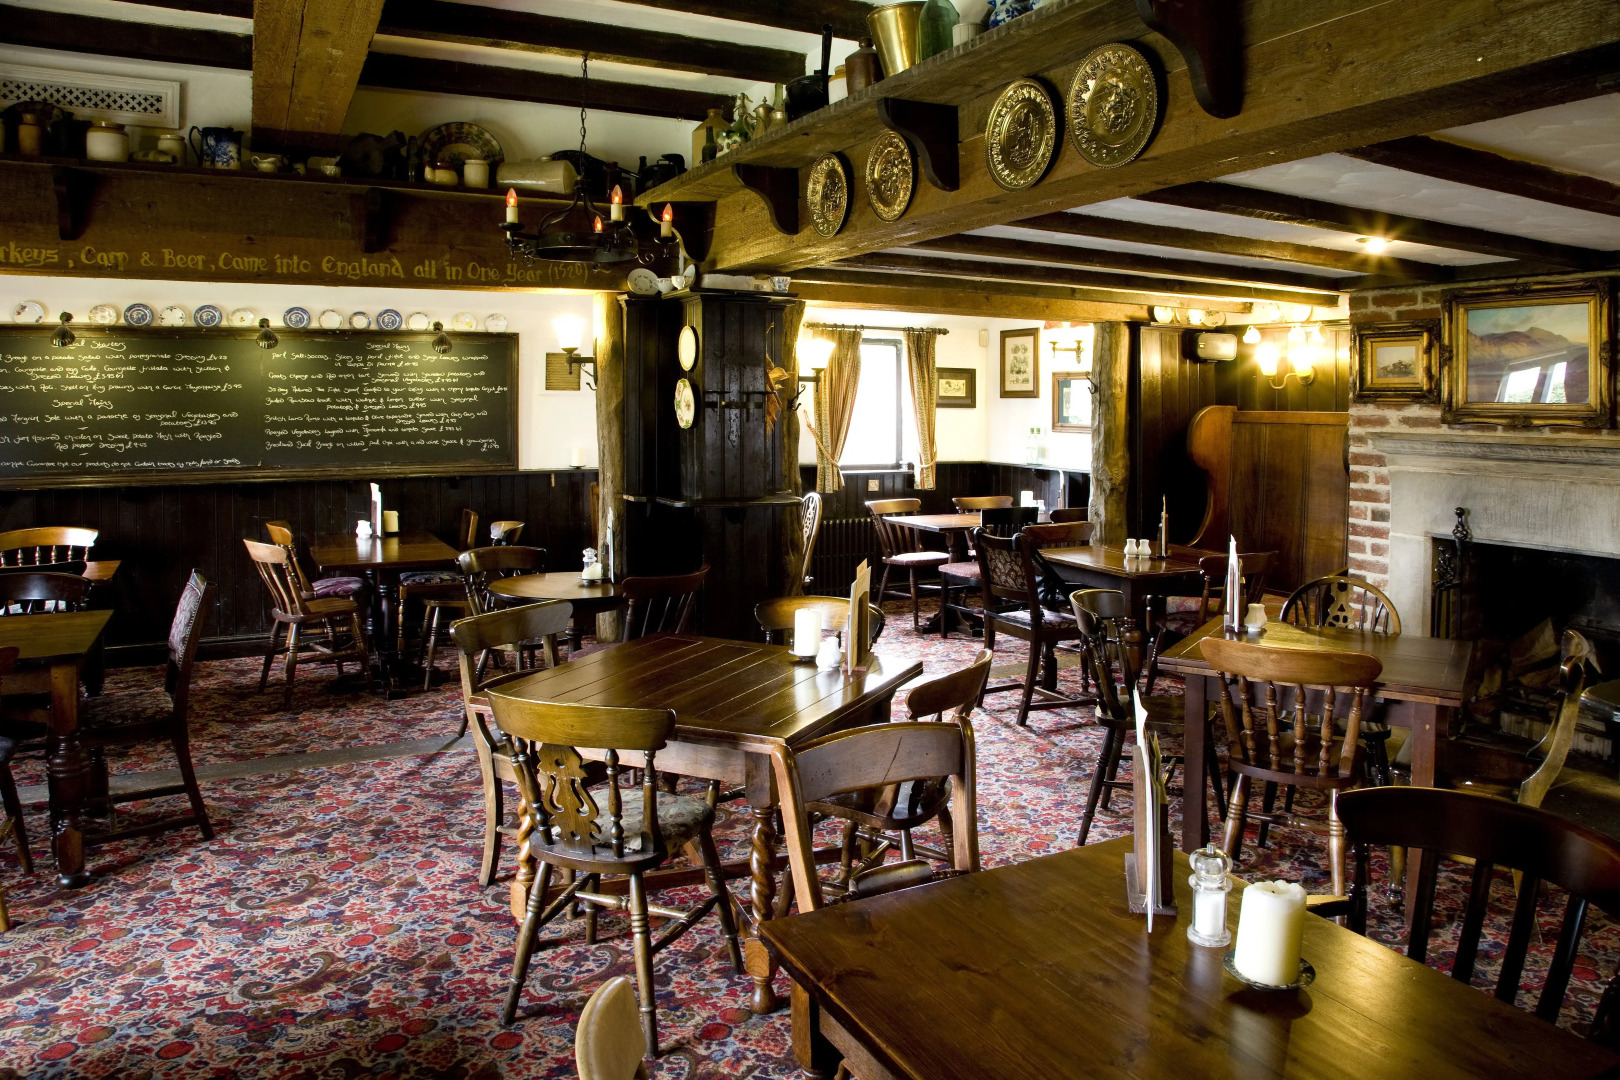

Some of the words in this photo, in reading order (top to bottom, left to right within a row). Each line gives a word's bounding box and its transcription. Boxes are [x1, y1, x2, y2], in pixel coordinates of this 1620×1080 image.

[81, 246, 129, 271] Carp
[140, 252, 158, 267] &
[219, 252, 270, 272] Came
[274, 253, 312, 274] into
[321, 255, 406, 280] England
[414, 258, 438, 279] all
[443, 254, 463, 280] in
[467, 261, 501, 281] One
[502, 263, 543, 283] Year
[52, 399, 84, 408] Special
